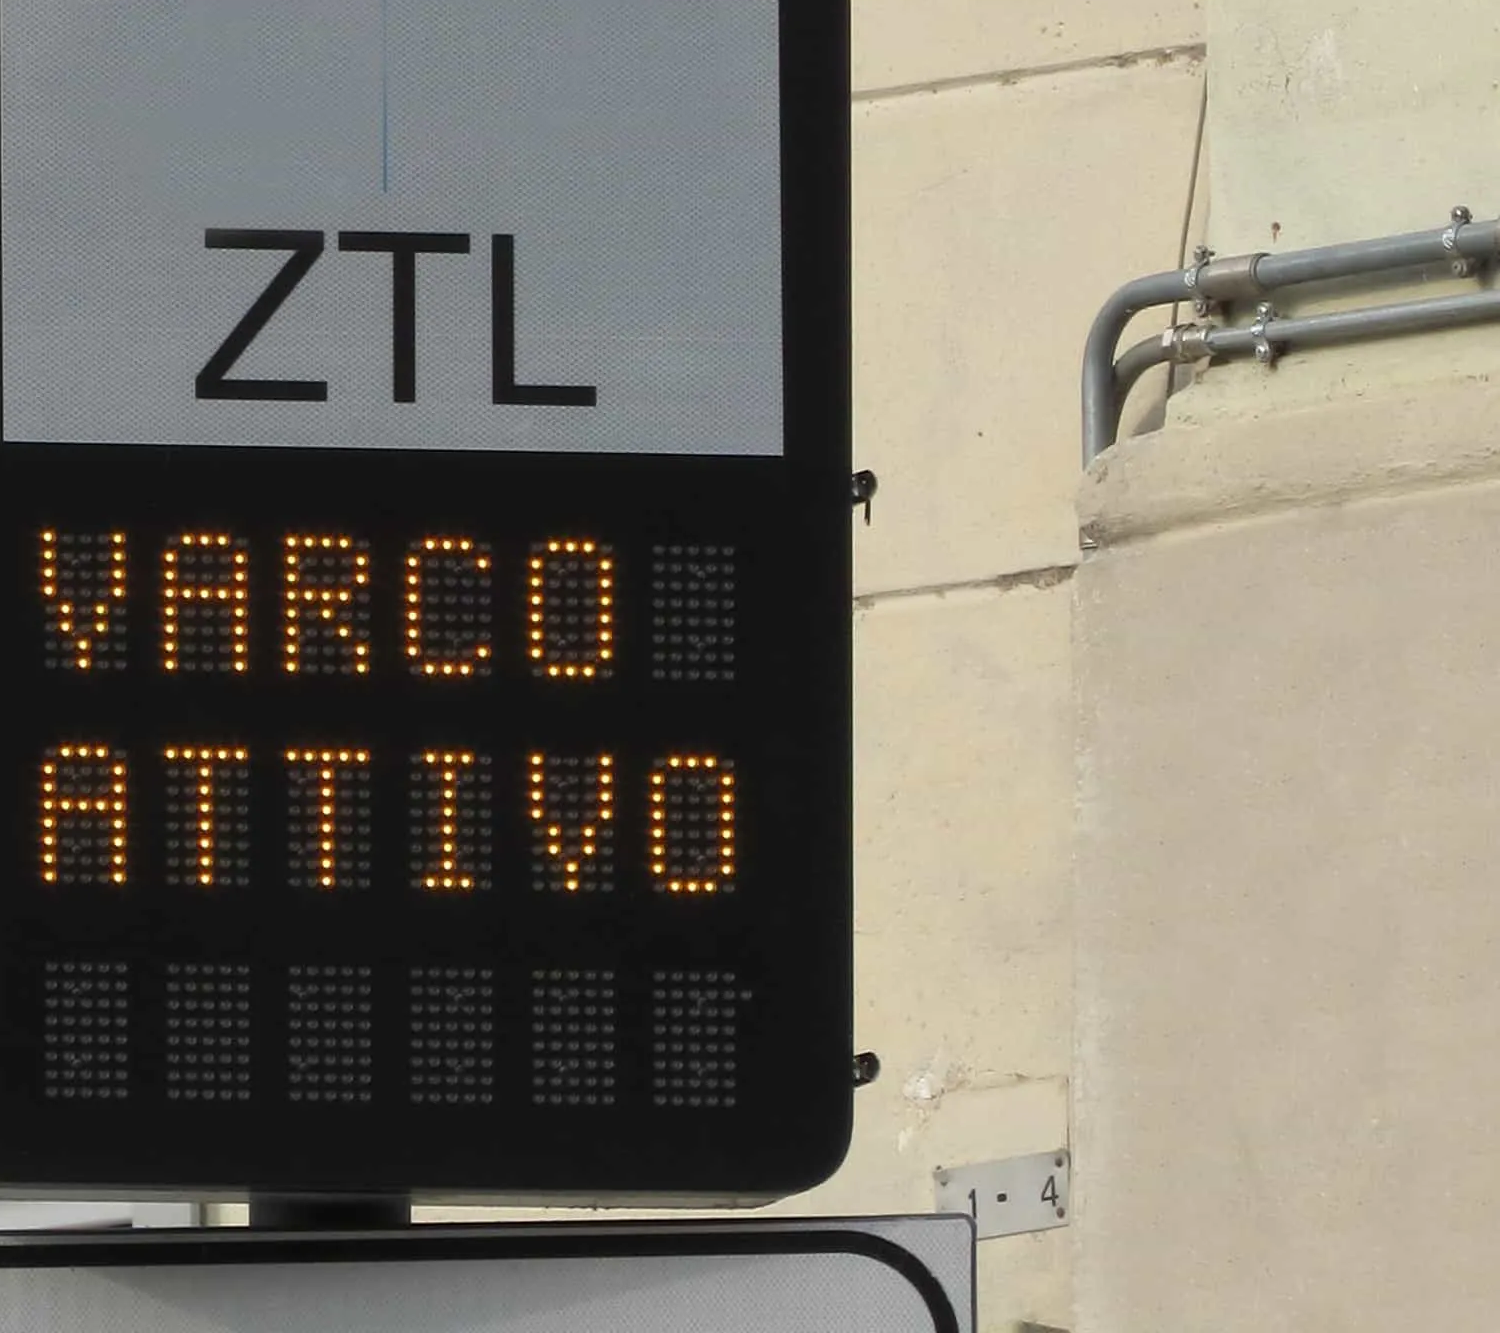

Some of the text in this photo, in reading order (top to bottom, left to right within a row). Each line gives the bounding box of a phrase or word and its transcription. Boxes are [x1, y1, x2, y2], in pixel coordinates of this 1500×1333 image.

[194, 228, 597, 407] ZTL
[40, 530, 613, 678] VARCO
[40, 745, 735, 892] ATTIVO
